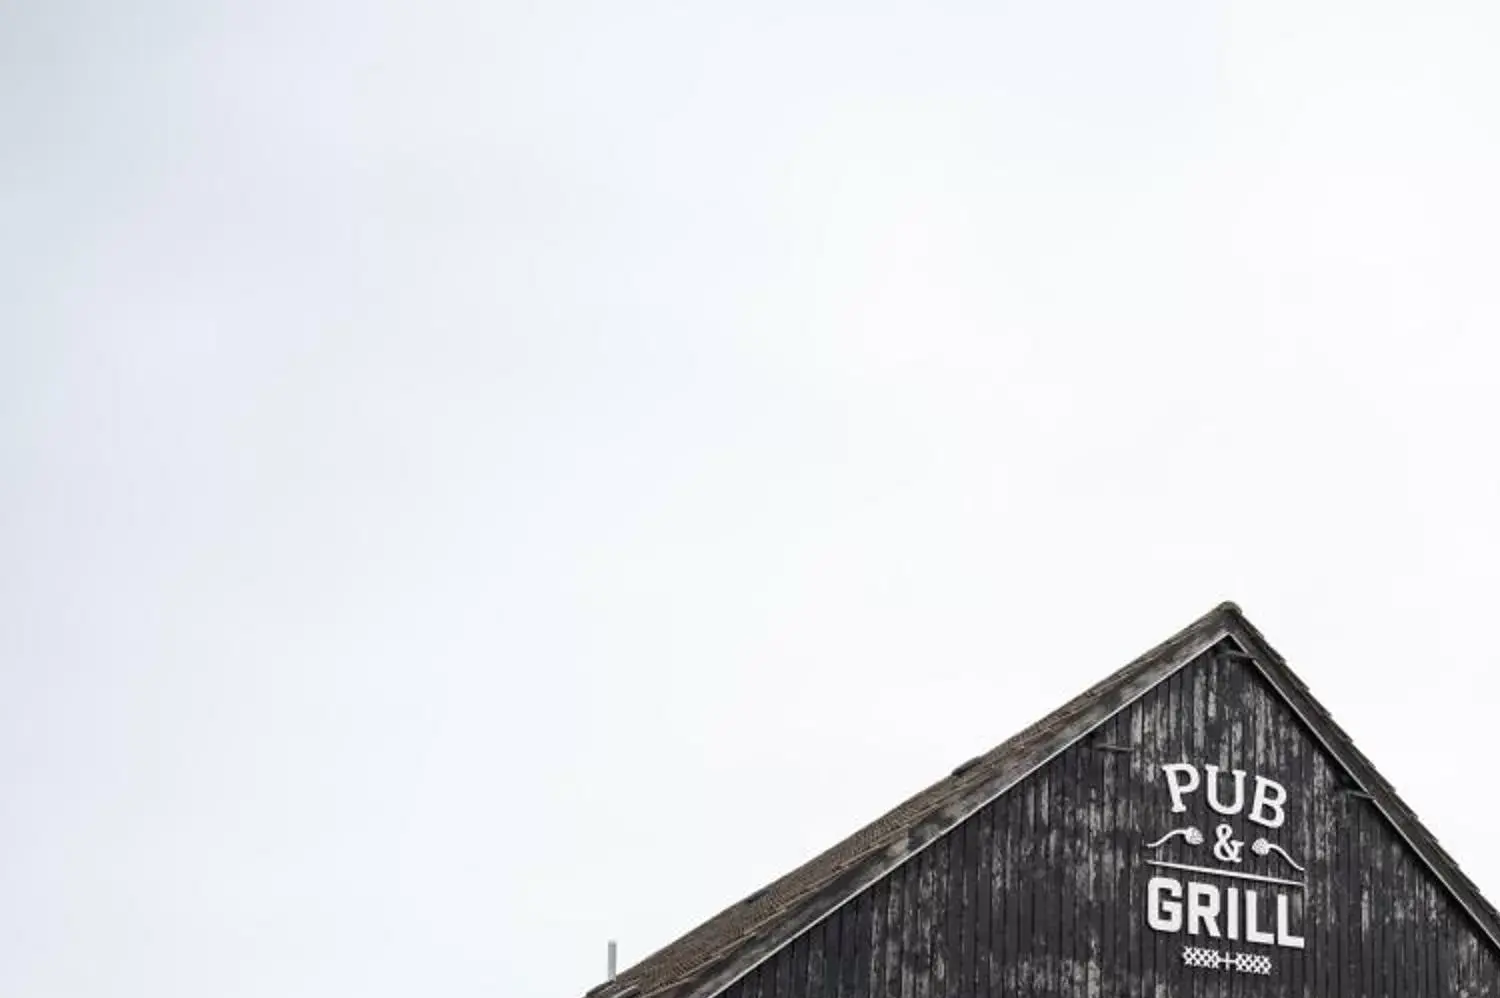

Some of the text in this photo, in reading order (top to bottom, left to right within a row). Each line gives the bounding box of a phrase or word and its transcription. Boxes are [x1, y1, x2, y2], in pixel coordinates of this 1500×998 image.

[1162, 763, 1287, 829] PUB
[1213, 824, 1245, 863] &
[1147, 877, 1305, 948] GRILL
